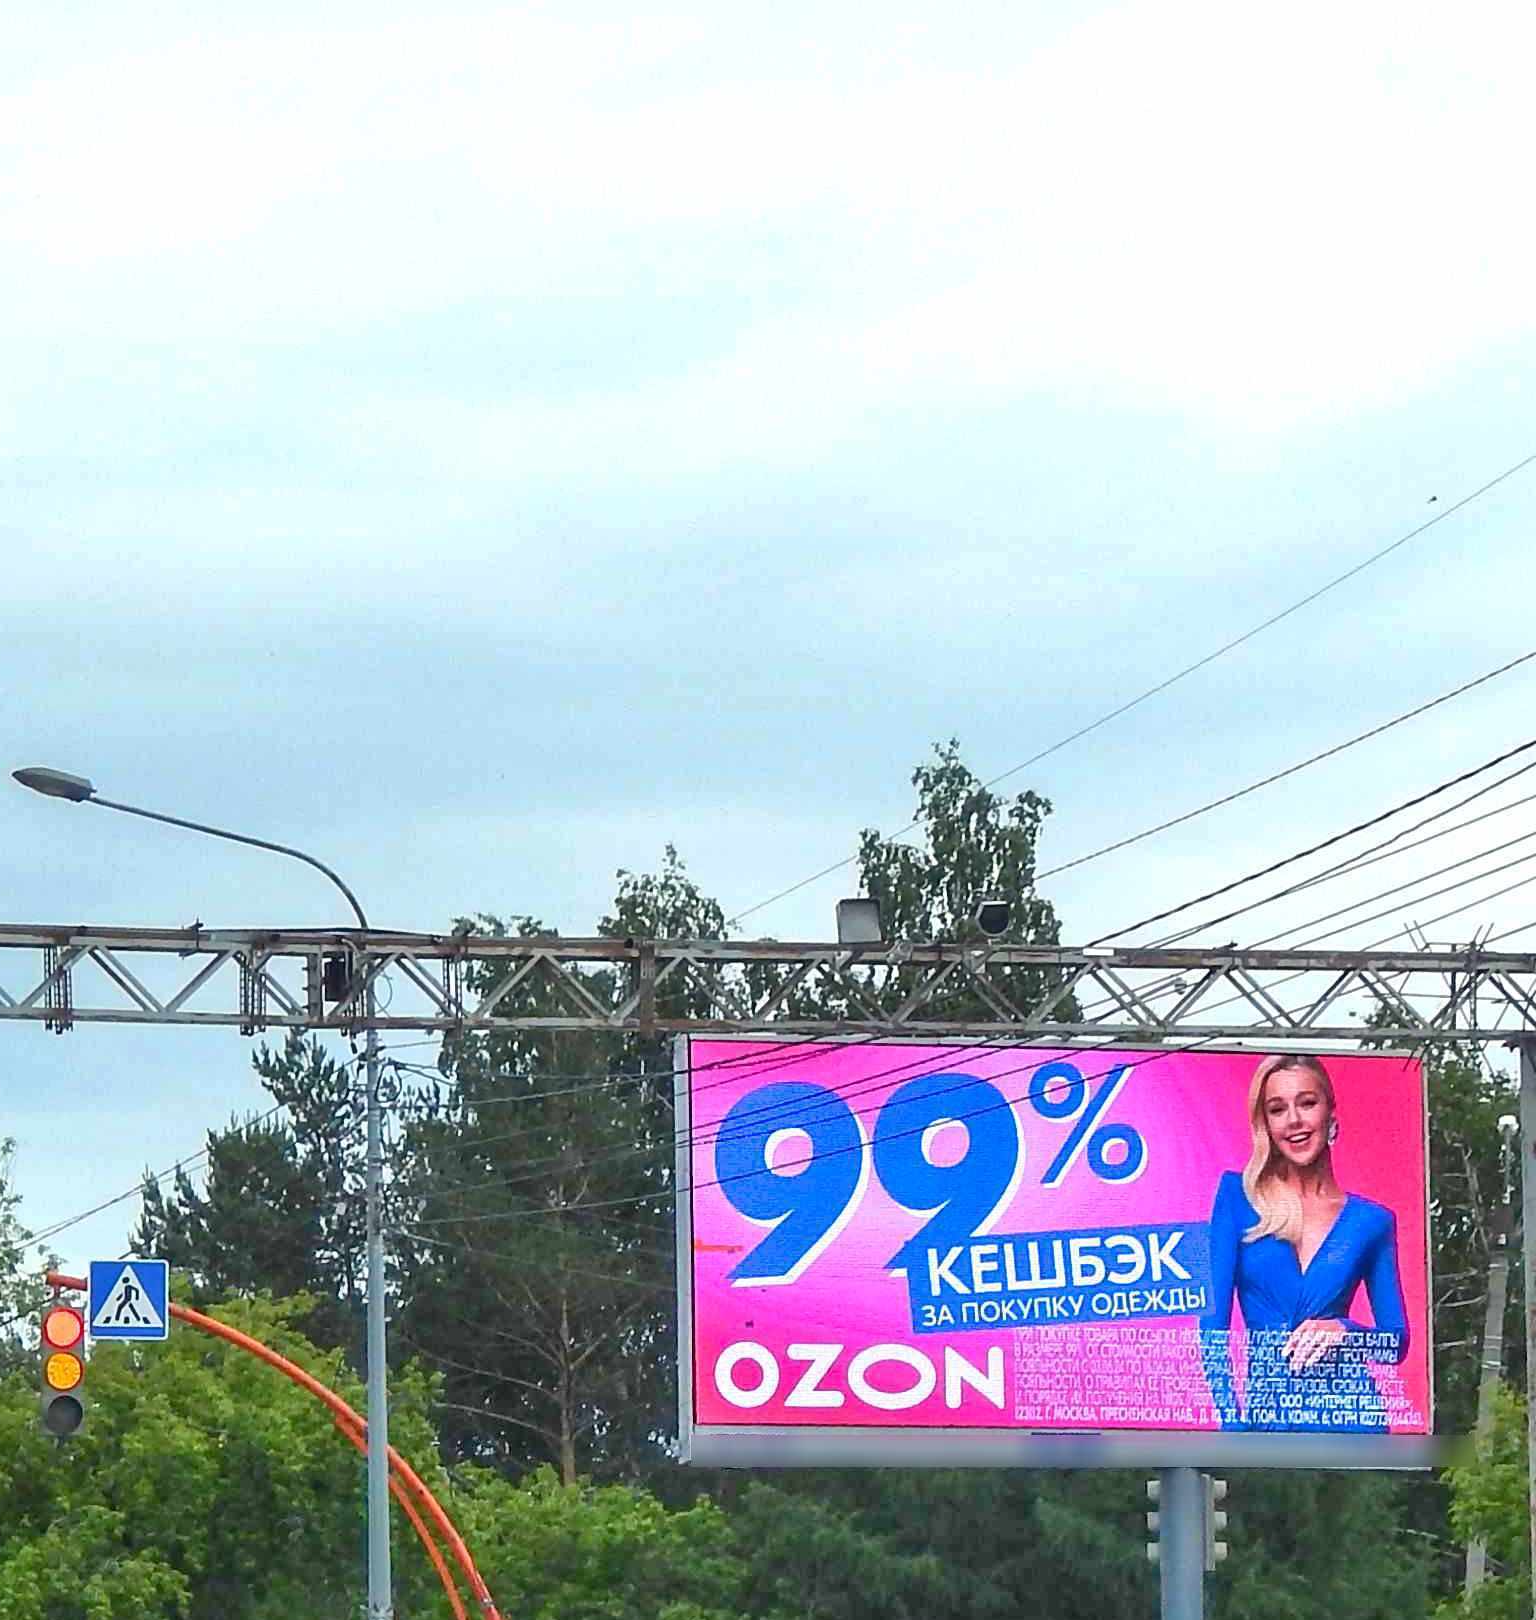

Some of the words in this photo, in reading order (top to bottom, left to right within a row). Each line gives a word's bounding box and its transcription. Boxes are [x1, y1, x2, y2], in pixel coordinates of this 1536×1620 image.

[714, 1062, 1148, 1288] 99%
[927, 1231, 1192, 1296] КЕШБЭК
[921, 1304, 955, 1327] ЗА
[961, 1295, 1084, 1323] ПОКУПКУ
[1091, 1286, 1207, 1317] ОДЕЖДЫ
[714, 1340, 1006, 1410] OZON
